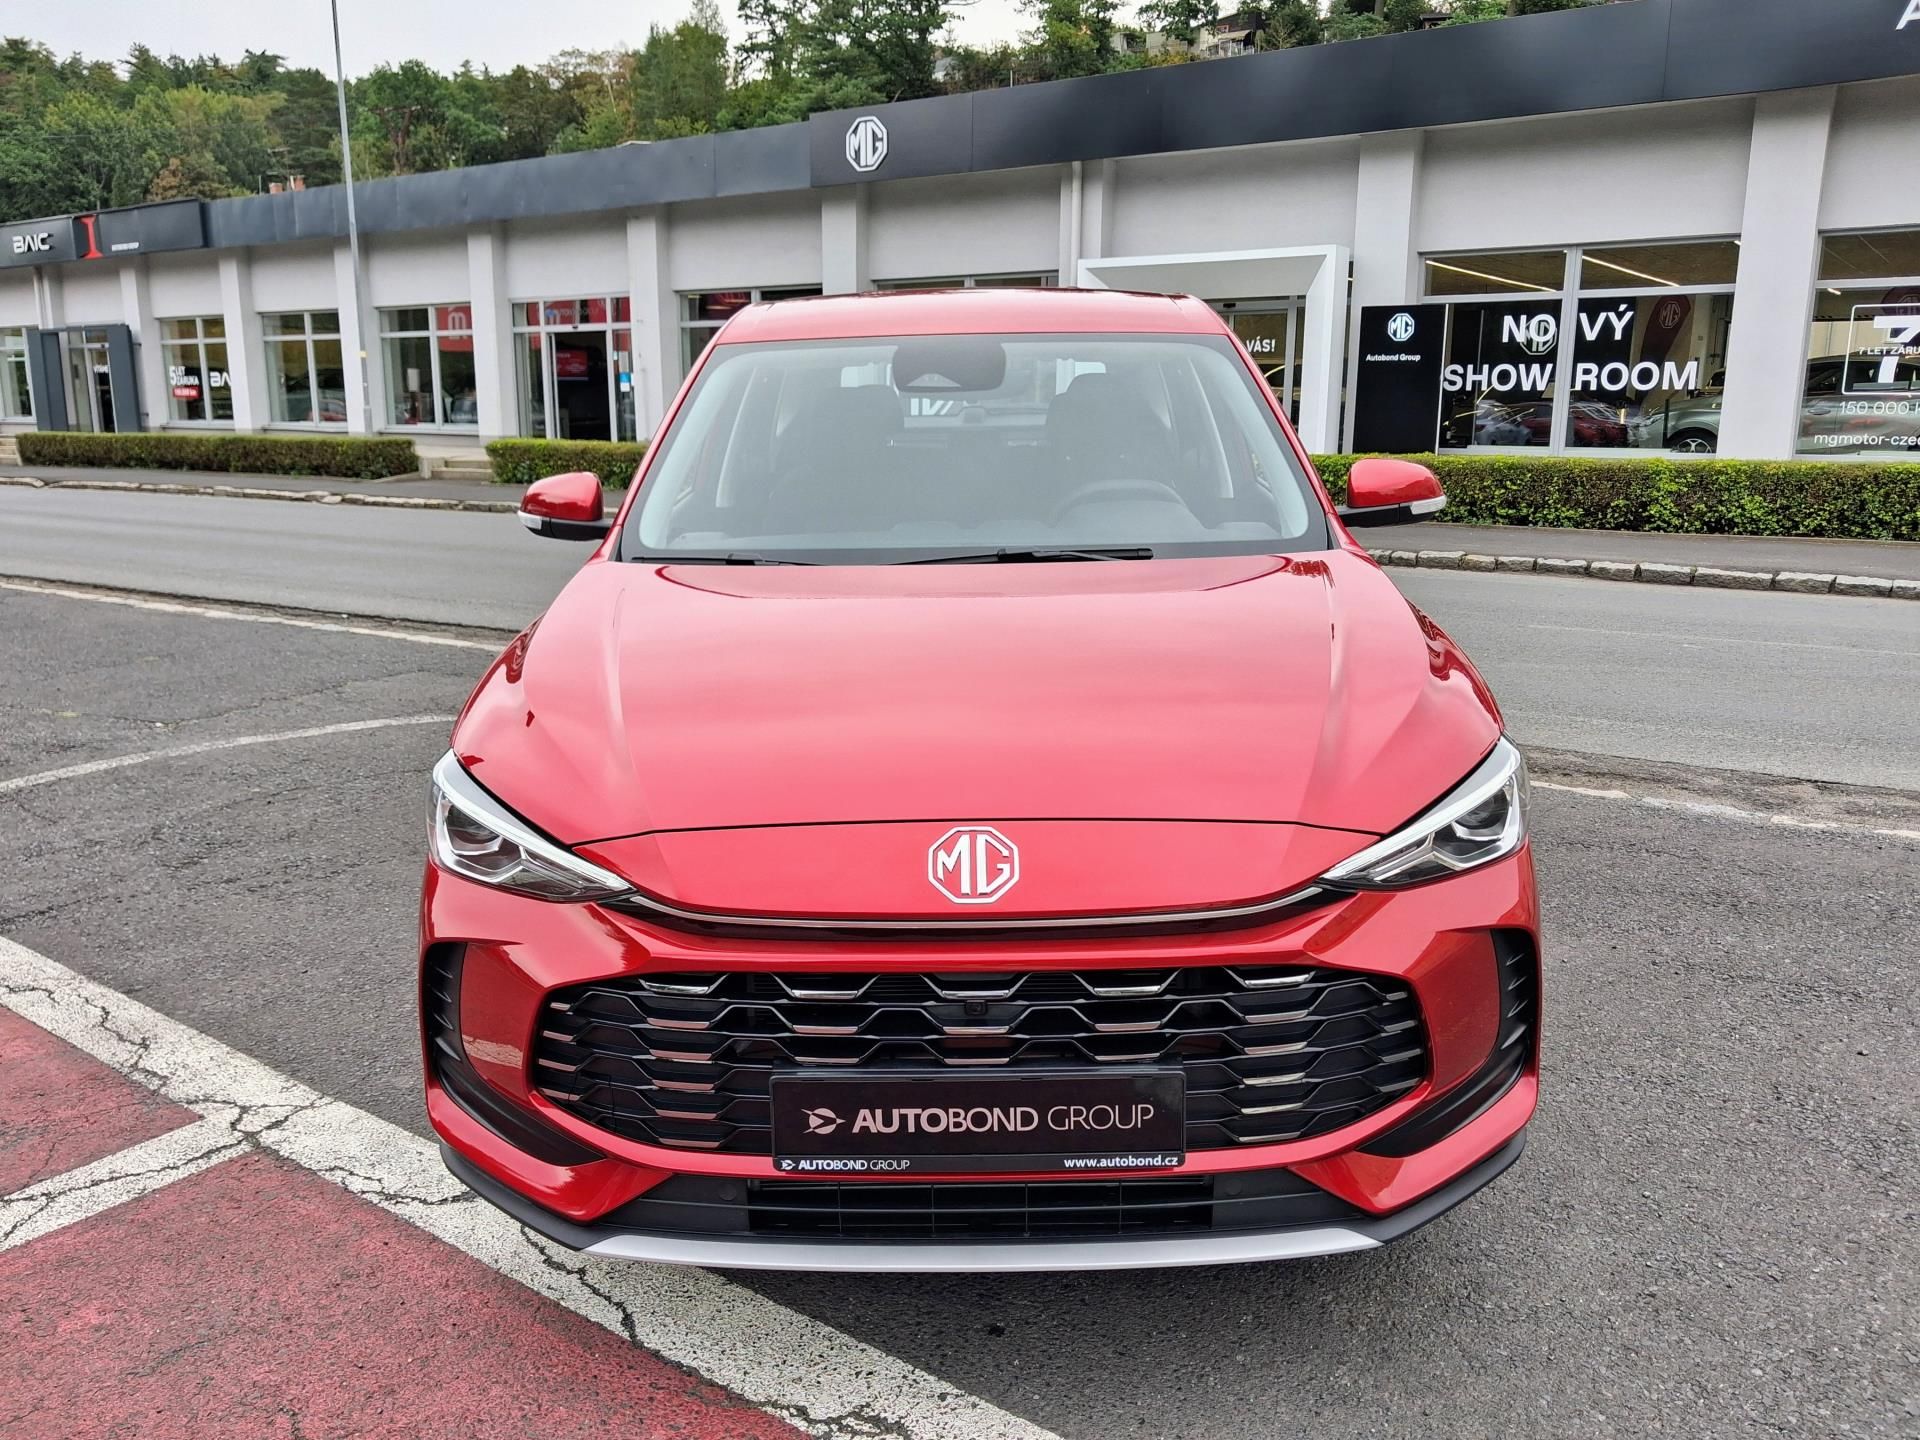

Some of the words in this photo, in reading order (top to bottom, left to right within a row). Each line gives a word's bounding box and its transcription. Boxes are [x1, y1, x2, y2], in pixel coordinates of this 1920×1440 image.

[848, 120, 884, 167] MG
[12, 232, 50, 254] BAIC
[1390, 315, 1413, 339] MG
[1246, 336, 1276, 352] VÁS!
[1867, 346, 1888, 355] LET
[1366, 353, 1399, 362] Autobond
[1400, 353, 1421, 363] Group
[1839, 401, 1869, 415] 150
[1873, 401, 1910, 415] 000
[937, 833, 1011, 895] MG
[852, 1106, 1039, 1133] AUTOBOND
[1047, 1104, 1154, 1131] GROUP
[798, 1159, 868, 1171] AUTOBOND
[869, 1159, 910, 1171] GROUP
[1064, 1155, 1178, 1168] www.autobond.cz
